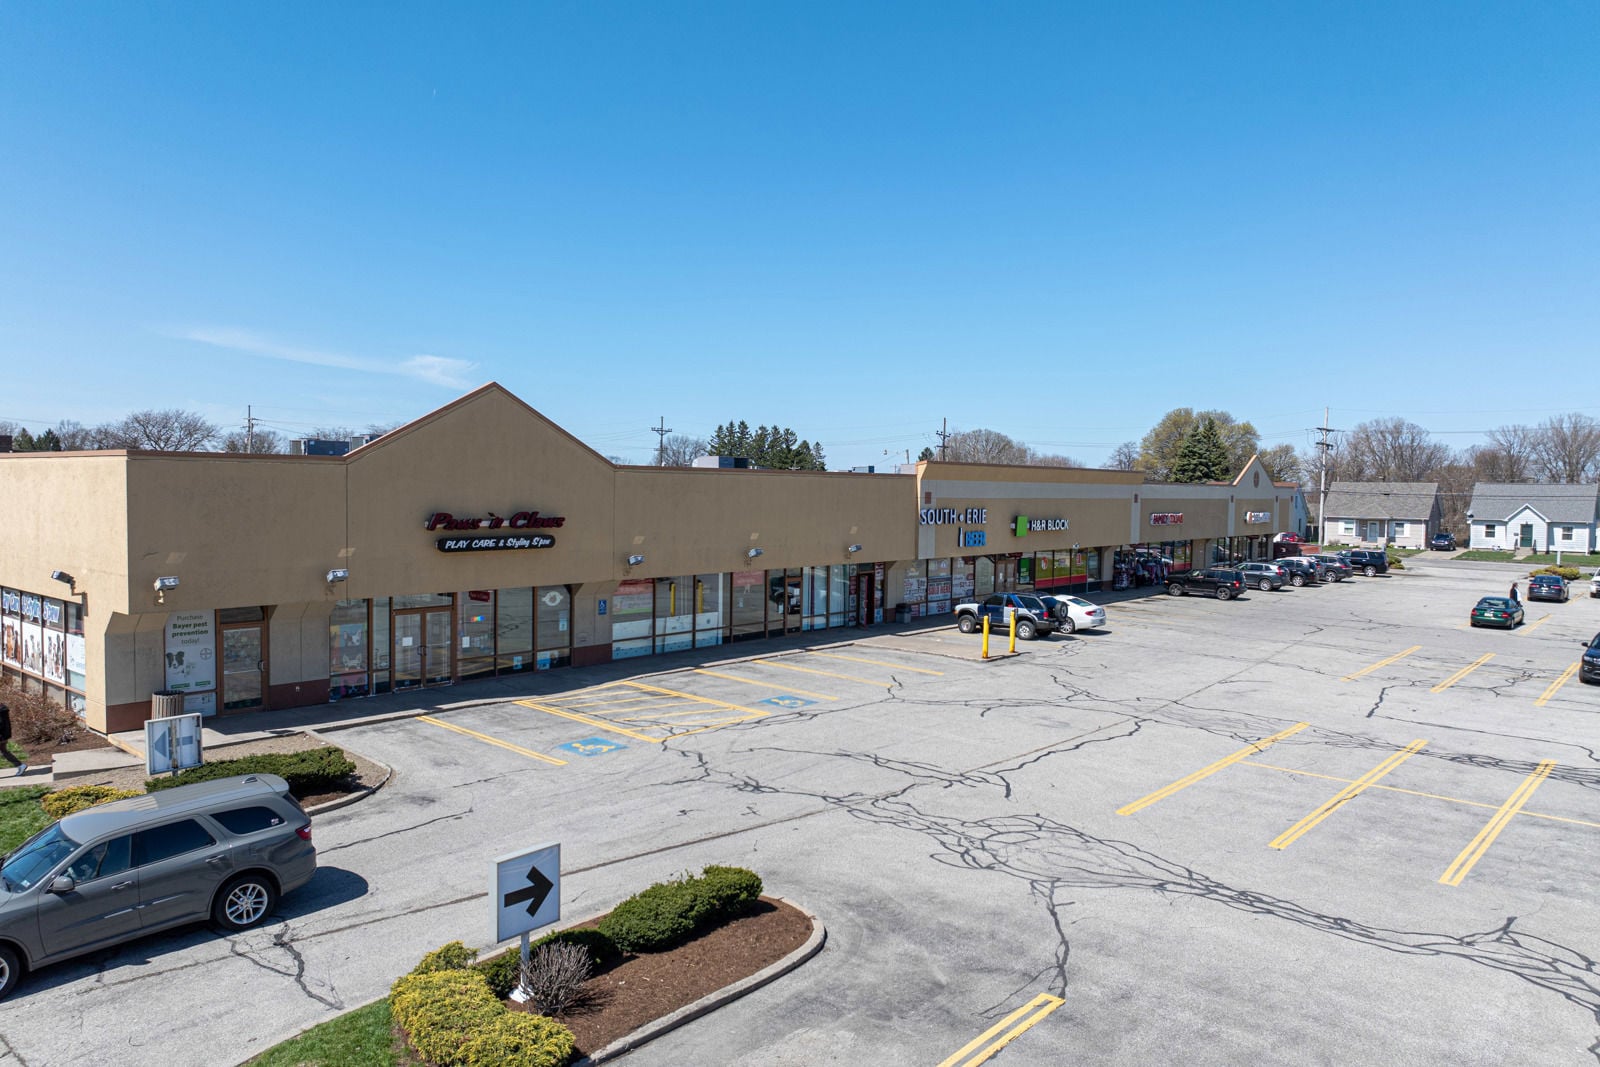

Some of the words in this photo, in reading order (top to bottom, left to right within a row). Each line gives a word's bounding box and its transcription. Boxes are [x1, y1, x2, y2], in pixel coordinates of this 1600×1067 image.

[427, 512, 482, 531] Paws
[509, 511, 566, 528] Claws
[920, 508, 957, 525] SOUTH
[966, 508, 988, 524] ERIE
[1031, 519, 1047, 531] H&R
[1047, 519, 1069, 531] BLOCK
[445, 540, 470, 549] PLAY
[472, 538, 496, 548] CARE
[506, 537, 530, 549] Styling
[172, 622, 192, 630] Bayer
[193, 621, 208, 629] pest
[172, 629, 209, 638] prevention
